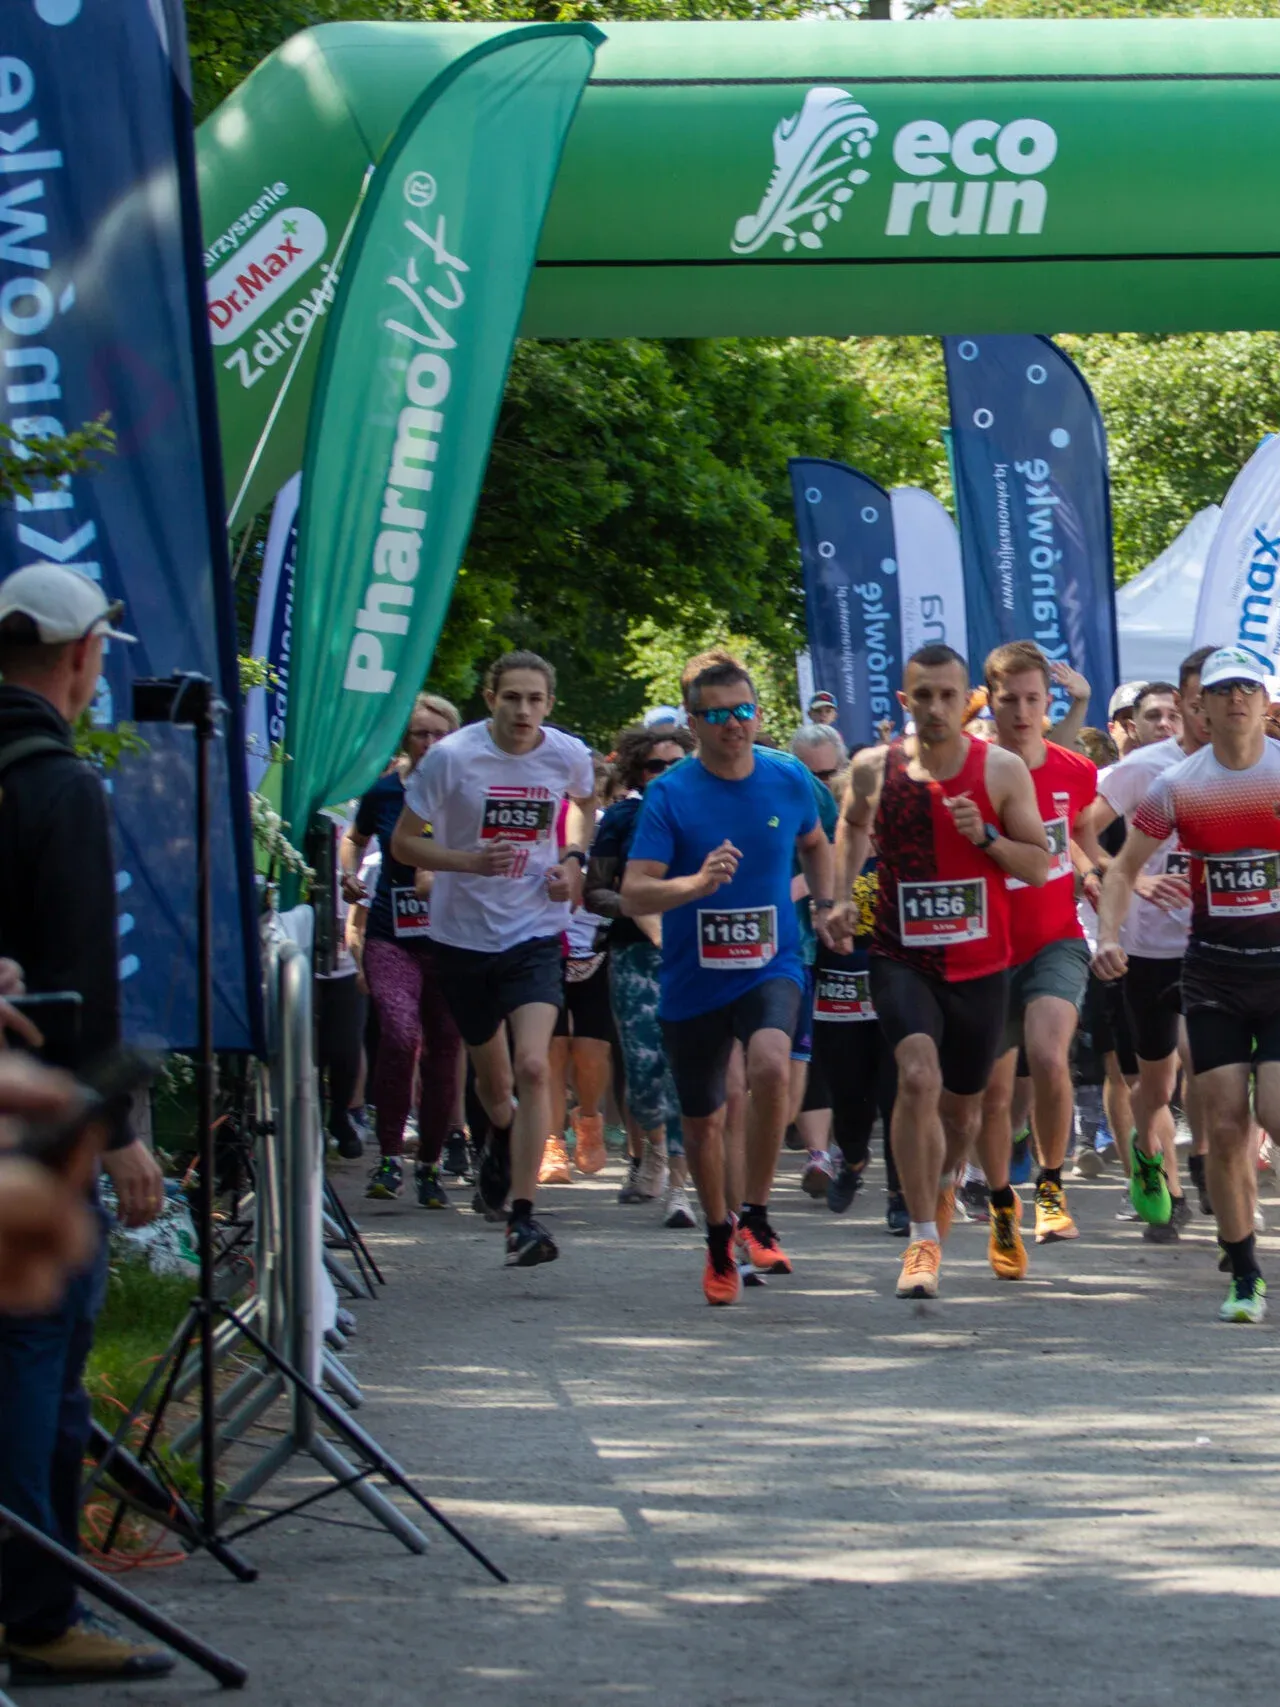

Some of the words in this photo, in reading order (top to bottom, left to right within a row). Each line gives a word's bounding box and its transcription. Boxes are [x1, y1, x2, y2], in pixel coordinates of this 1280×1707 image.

[893, 118, 1057, 176] eco
[202, 181, 290, 268] arzyszenie
[885, 180, 1048, 236] run
[223, 264, 340, 389] Zdrowi
[486, 808, 540, 827] 1035
[1211, 869, 1268, 889] 1146
[905, 896, 966, 917] 1156
[703, 922, 761, 942] 1163
